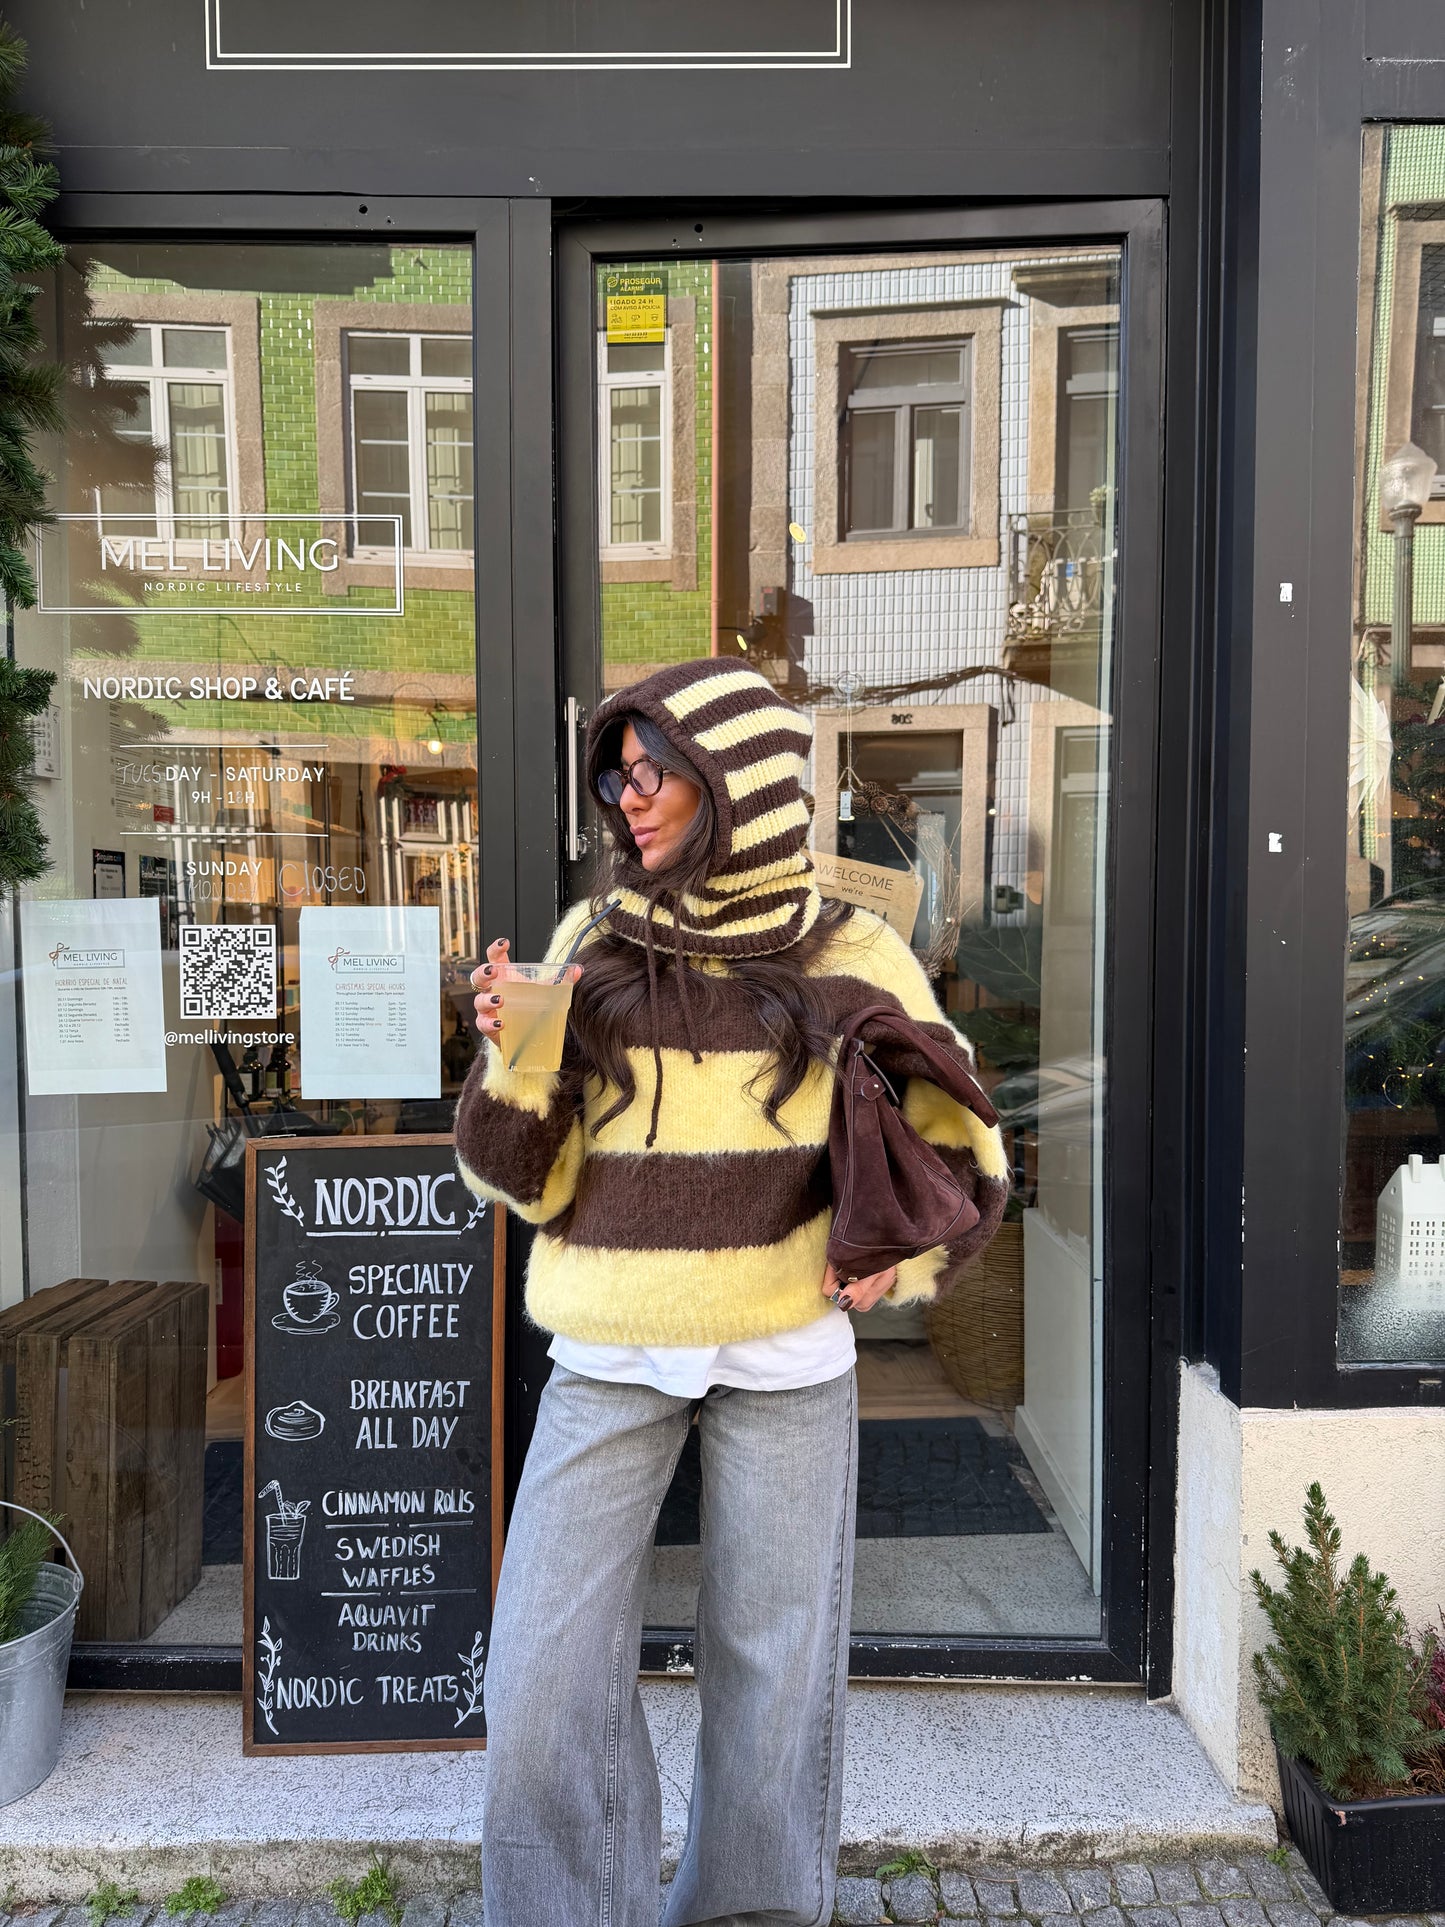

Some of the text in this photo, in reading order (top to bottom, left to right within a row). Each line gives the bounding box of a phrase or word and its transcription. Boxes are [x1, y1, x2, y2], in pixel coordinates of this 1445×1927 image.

[101, 538, 339, 572] MEL LIVING
[144, 582, 302, 592] NORDIC LIFESTYLE
[83, 671, 355, 701] NORDIC SHOP & CAFÉ
[226, 766, 325, 782] SATURDAY
[192, 791, 210, 804] 9H
[186, 861, 262, 876] SUNDAY
[820, 863, 894, 891] WELCOME
[842, 886, 864, 897] we're
[86, 952, 118, 961] LIVING
[344, 958, 398, 966] MEL LIVING
[79, 978, 101, 986] ESPECIAL
[113, 977, 128, 985] NATAL
[164, 1029, 295, 1048] @mellivingstore
[314, 1173, 456, 1227] NORDIC
[349, 1263, 474, 1296] SPECIALTY
[353, 1304, 460, 1339] COFFEE
[350, 1379, 470, 1409] BREAKFAST
[355, 1416, 459, 1449] ALL DAY
[322, 1488, 475, 1517] CINNAMON ROLLS
[335, 1533, 441, 1561] SWEDISH
[342, 1563, 436, 1588] WAFFLES
[338, 1602, 436, 1628] AQUAVIT
[352, 1632, 422, 1653] DRINKS
[276, 1674, 459, 1710] NORDIC TREATS
